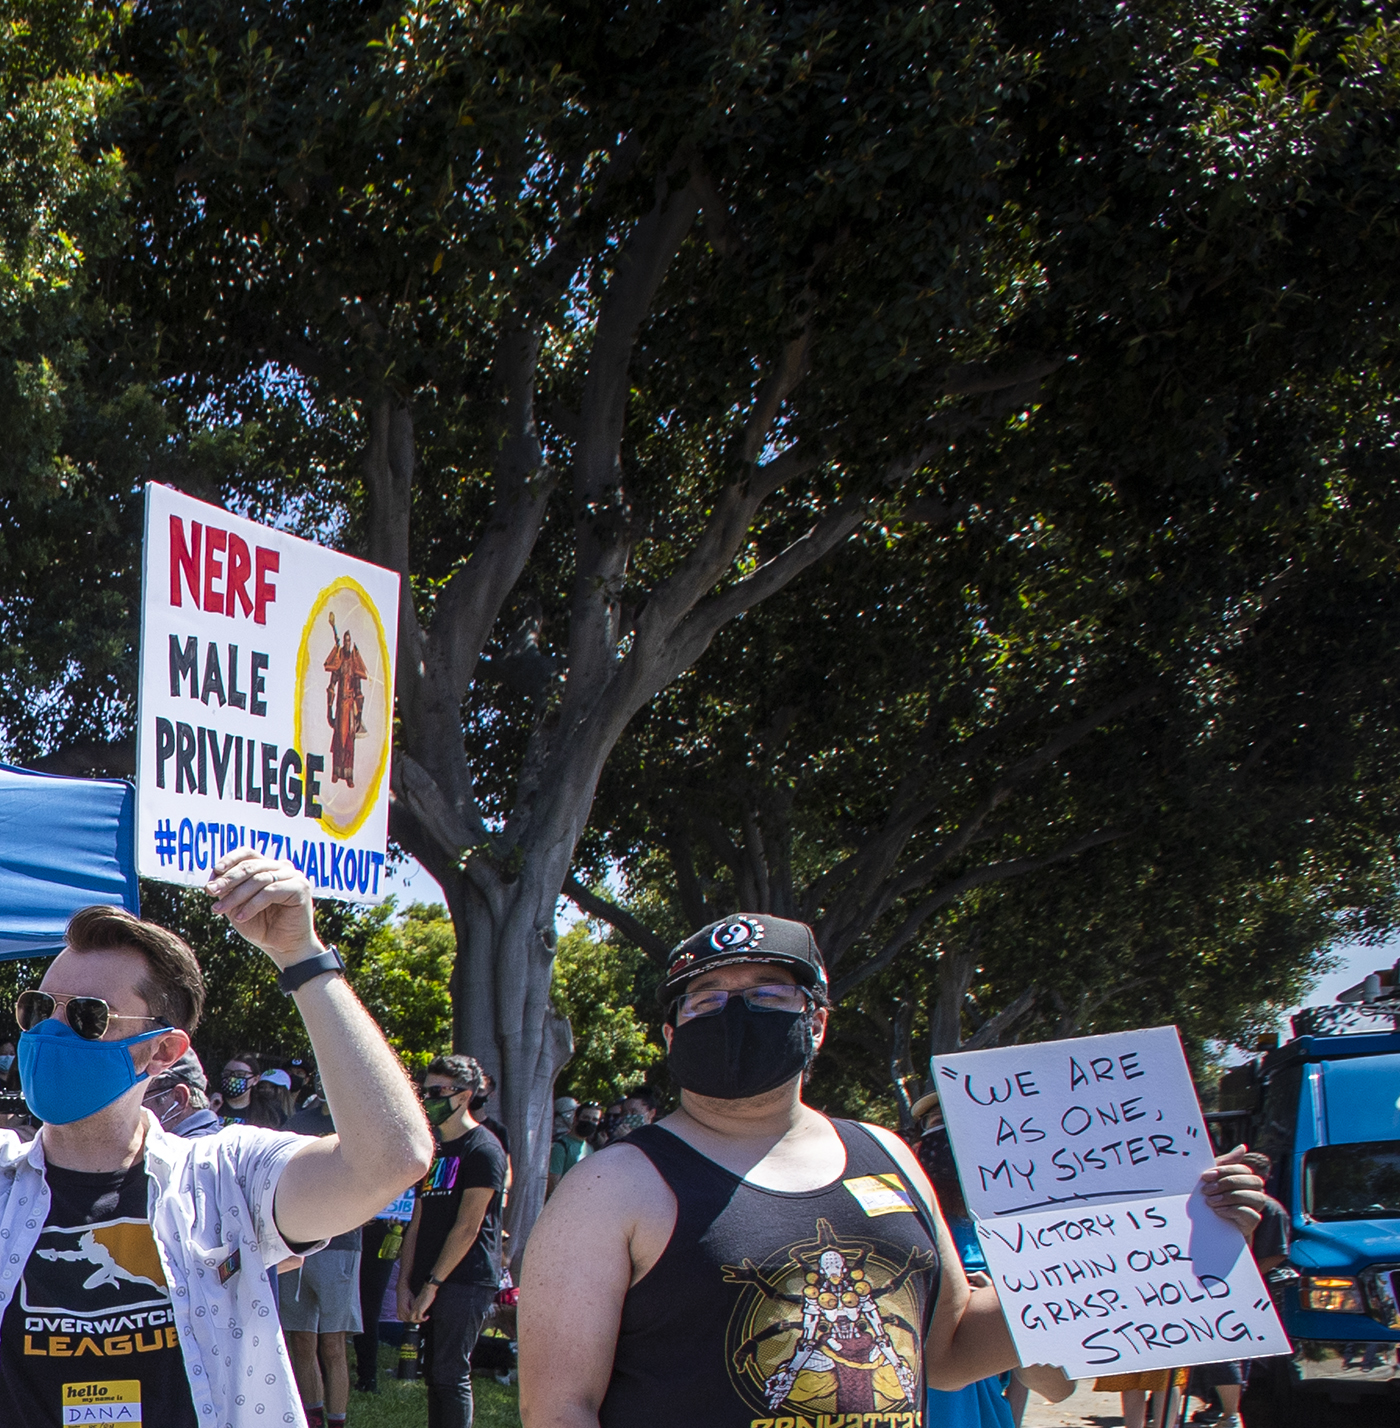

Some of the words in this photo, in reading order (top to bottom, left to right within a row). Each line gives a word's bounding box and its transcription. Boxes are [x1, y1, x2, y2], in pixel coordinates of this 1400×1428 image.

[170, 514, 280, 625] NERF
[168, 634, 269, 717] MALE
[156, 716, 325, 819] PRIVILEGE
[941, 1066, 1040, 1106] "WE
[1069, 1052, 1145, 1091] ARE
[996, 1115, 1046, 1146] AS
[1060, 1096, 1163, 1137] ONE,
[977, 1158, 1035, 1192] MY
[1126, 1206, 1167, 1230] IS
[1002, 1253, 1116, 1293] WITHIN
[1127, 1243, 1193, 1273] OUR
[1020, 1288, 1128, 1332] GRASP.
[1135, 1274, 1231, 1308] HOLD
[24, 1327, 179, 1356] LEAGUE
[66, 1384, 108, 1398] hello
[69, 1405, 132, 1422] DANA
